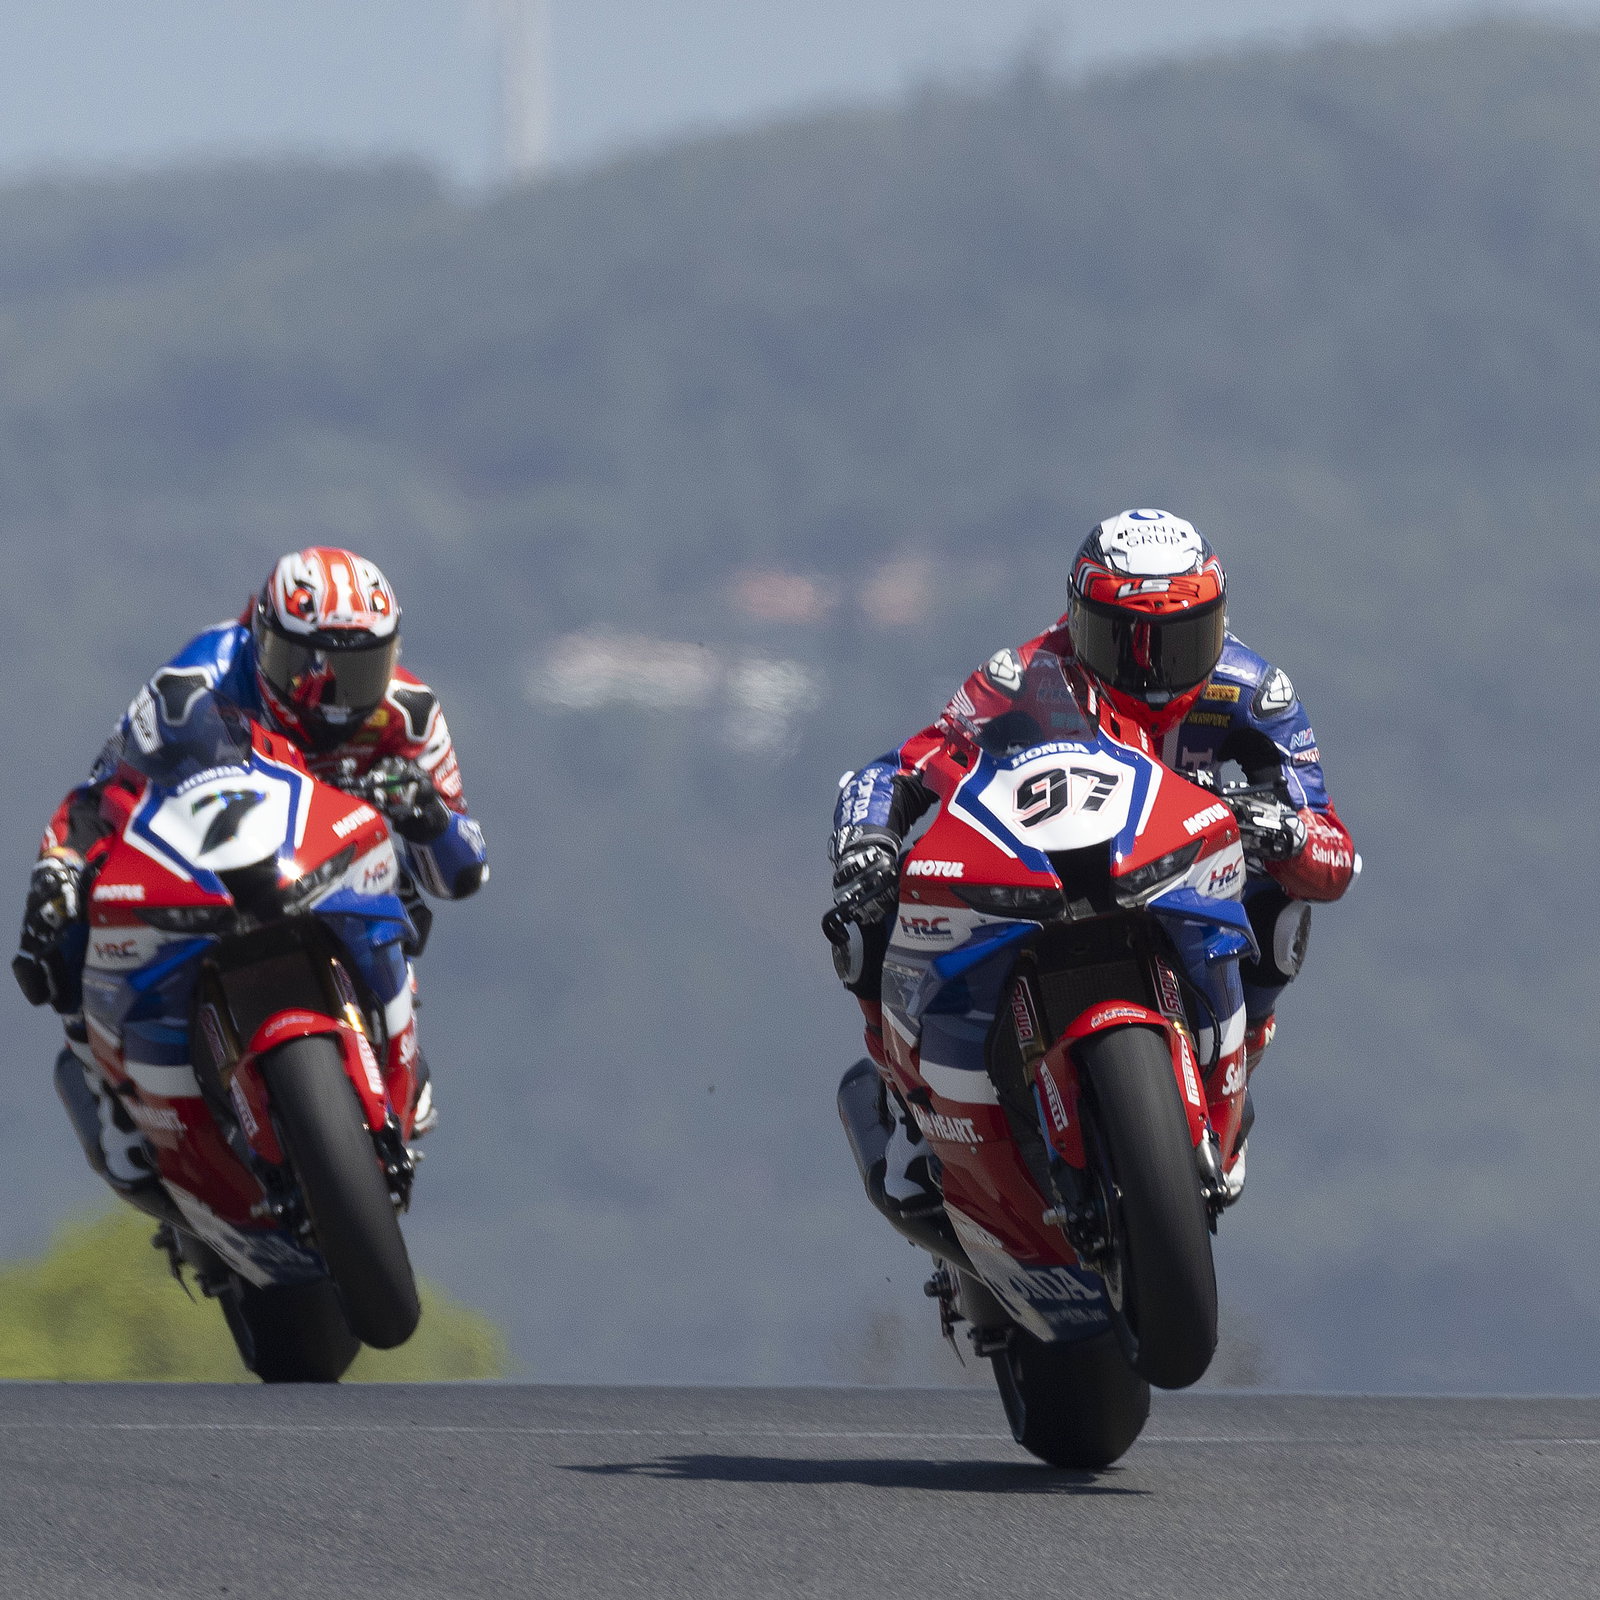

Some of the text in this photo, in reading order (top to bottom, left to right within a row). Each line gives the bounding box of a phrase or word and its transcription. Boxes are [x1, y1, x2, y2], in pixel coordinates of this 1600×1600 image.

[1124, 525, 1178, 536] PONT
[1126, 534, 1180, 547] GRUP
[1011, 742, 1090, 769] HONDA
[1014, 766, 1121, 829] 97
[191, 789, 267, 855] 7
[1182, 803, 1230, 836] MOTUL
[906, 860, 964, 878] MOTUL
[899, 915, 951, 935] HRC
